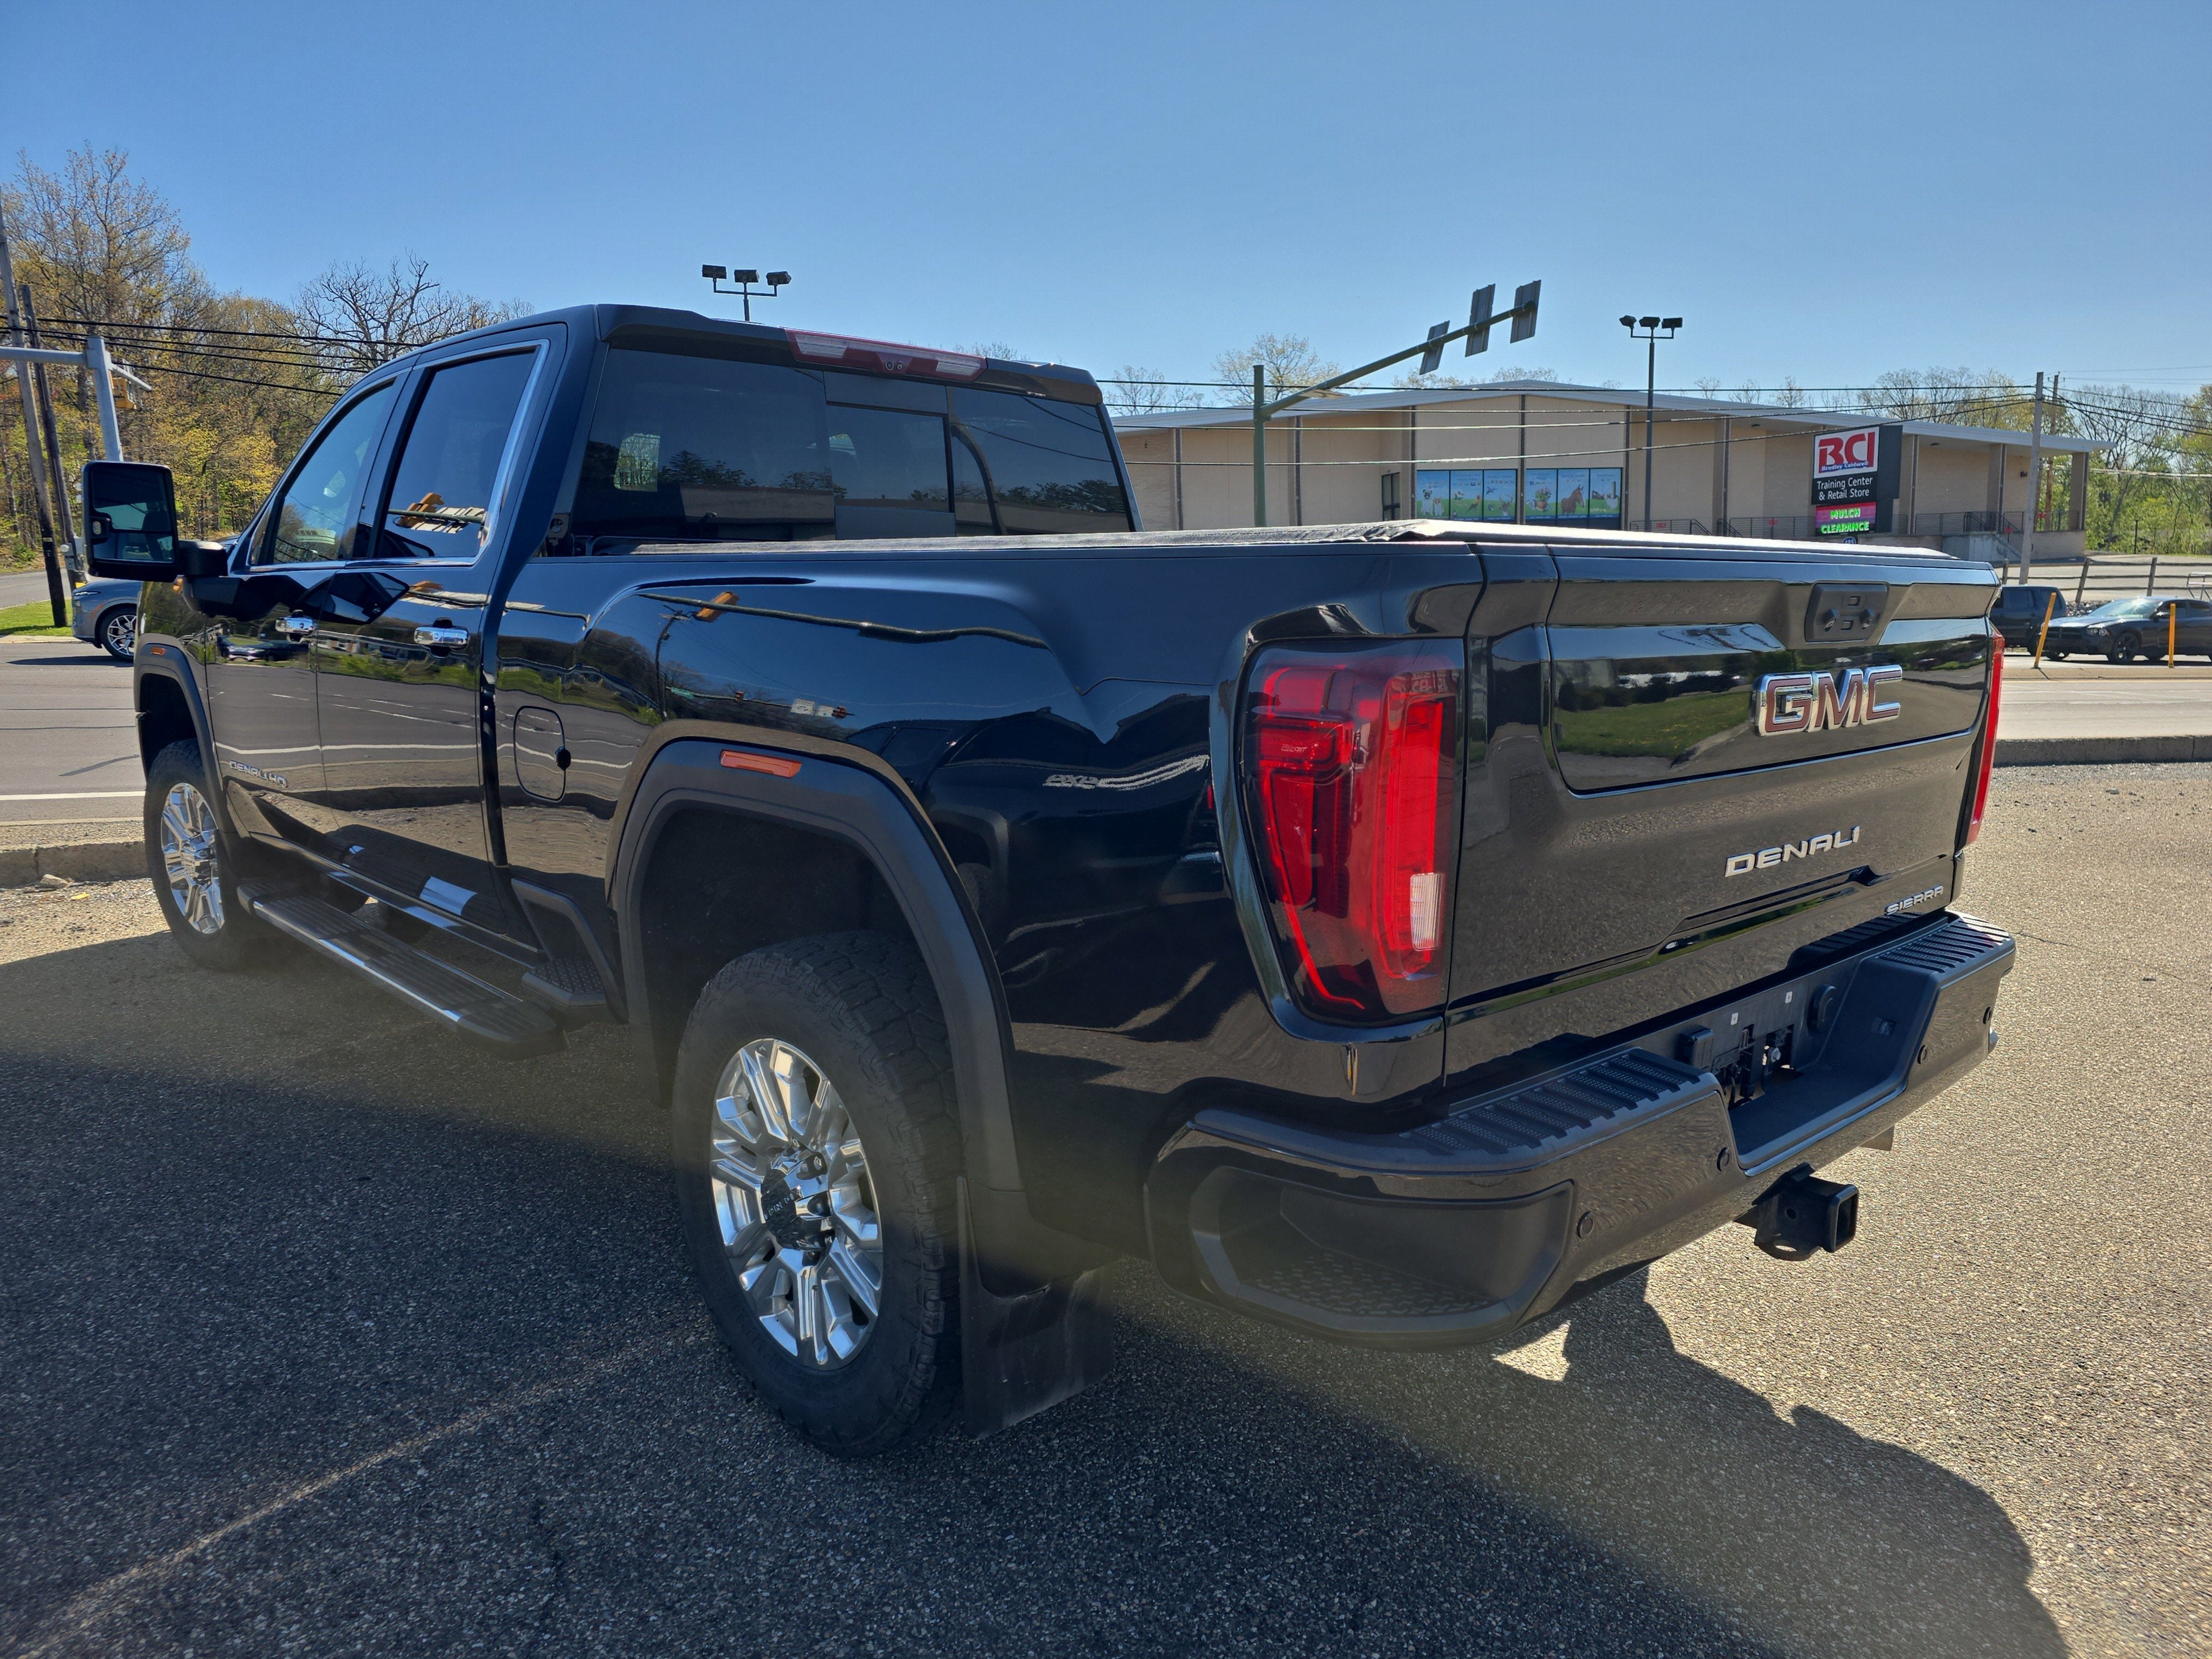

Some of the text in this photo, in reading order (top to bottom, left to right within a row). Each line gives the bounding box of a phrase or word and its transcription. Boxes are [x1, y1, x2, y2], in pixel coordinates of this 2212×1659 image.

[1817, 477, 1873, 490] Training Center
[1819, 488, 1870, 501] & Retail Store
[1830, 507, 1861, 519] MULCH
[1821, 521, 1869, 534] CLEARANCE
[1756, 665, 1902, 736] GMC
[229, 760, 267, 781] DENALI
[1725, 826, 1860, 877] DENALI
[1884, 885, 1944, 916] SIERRA
